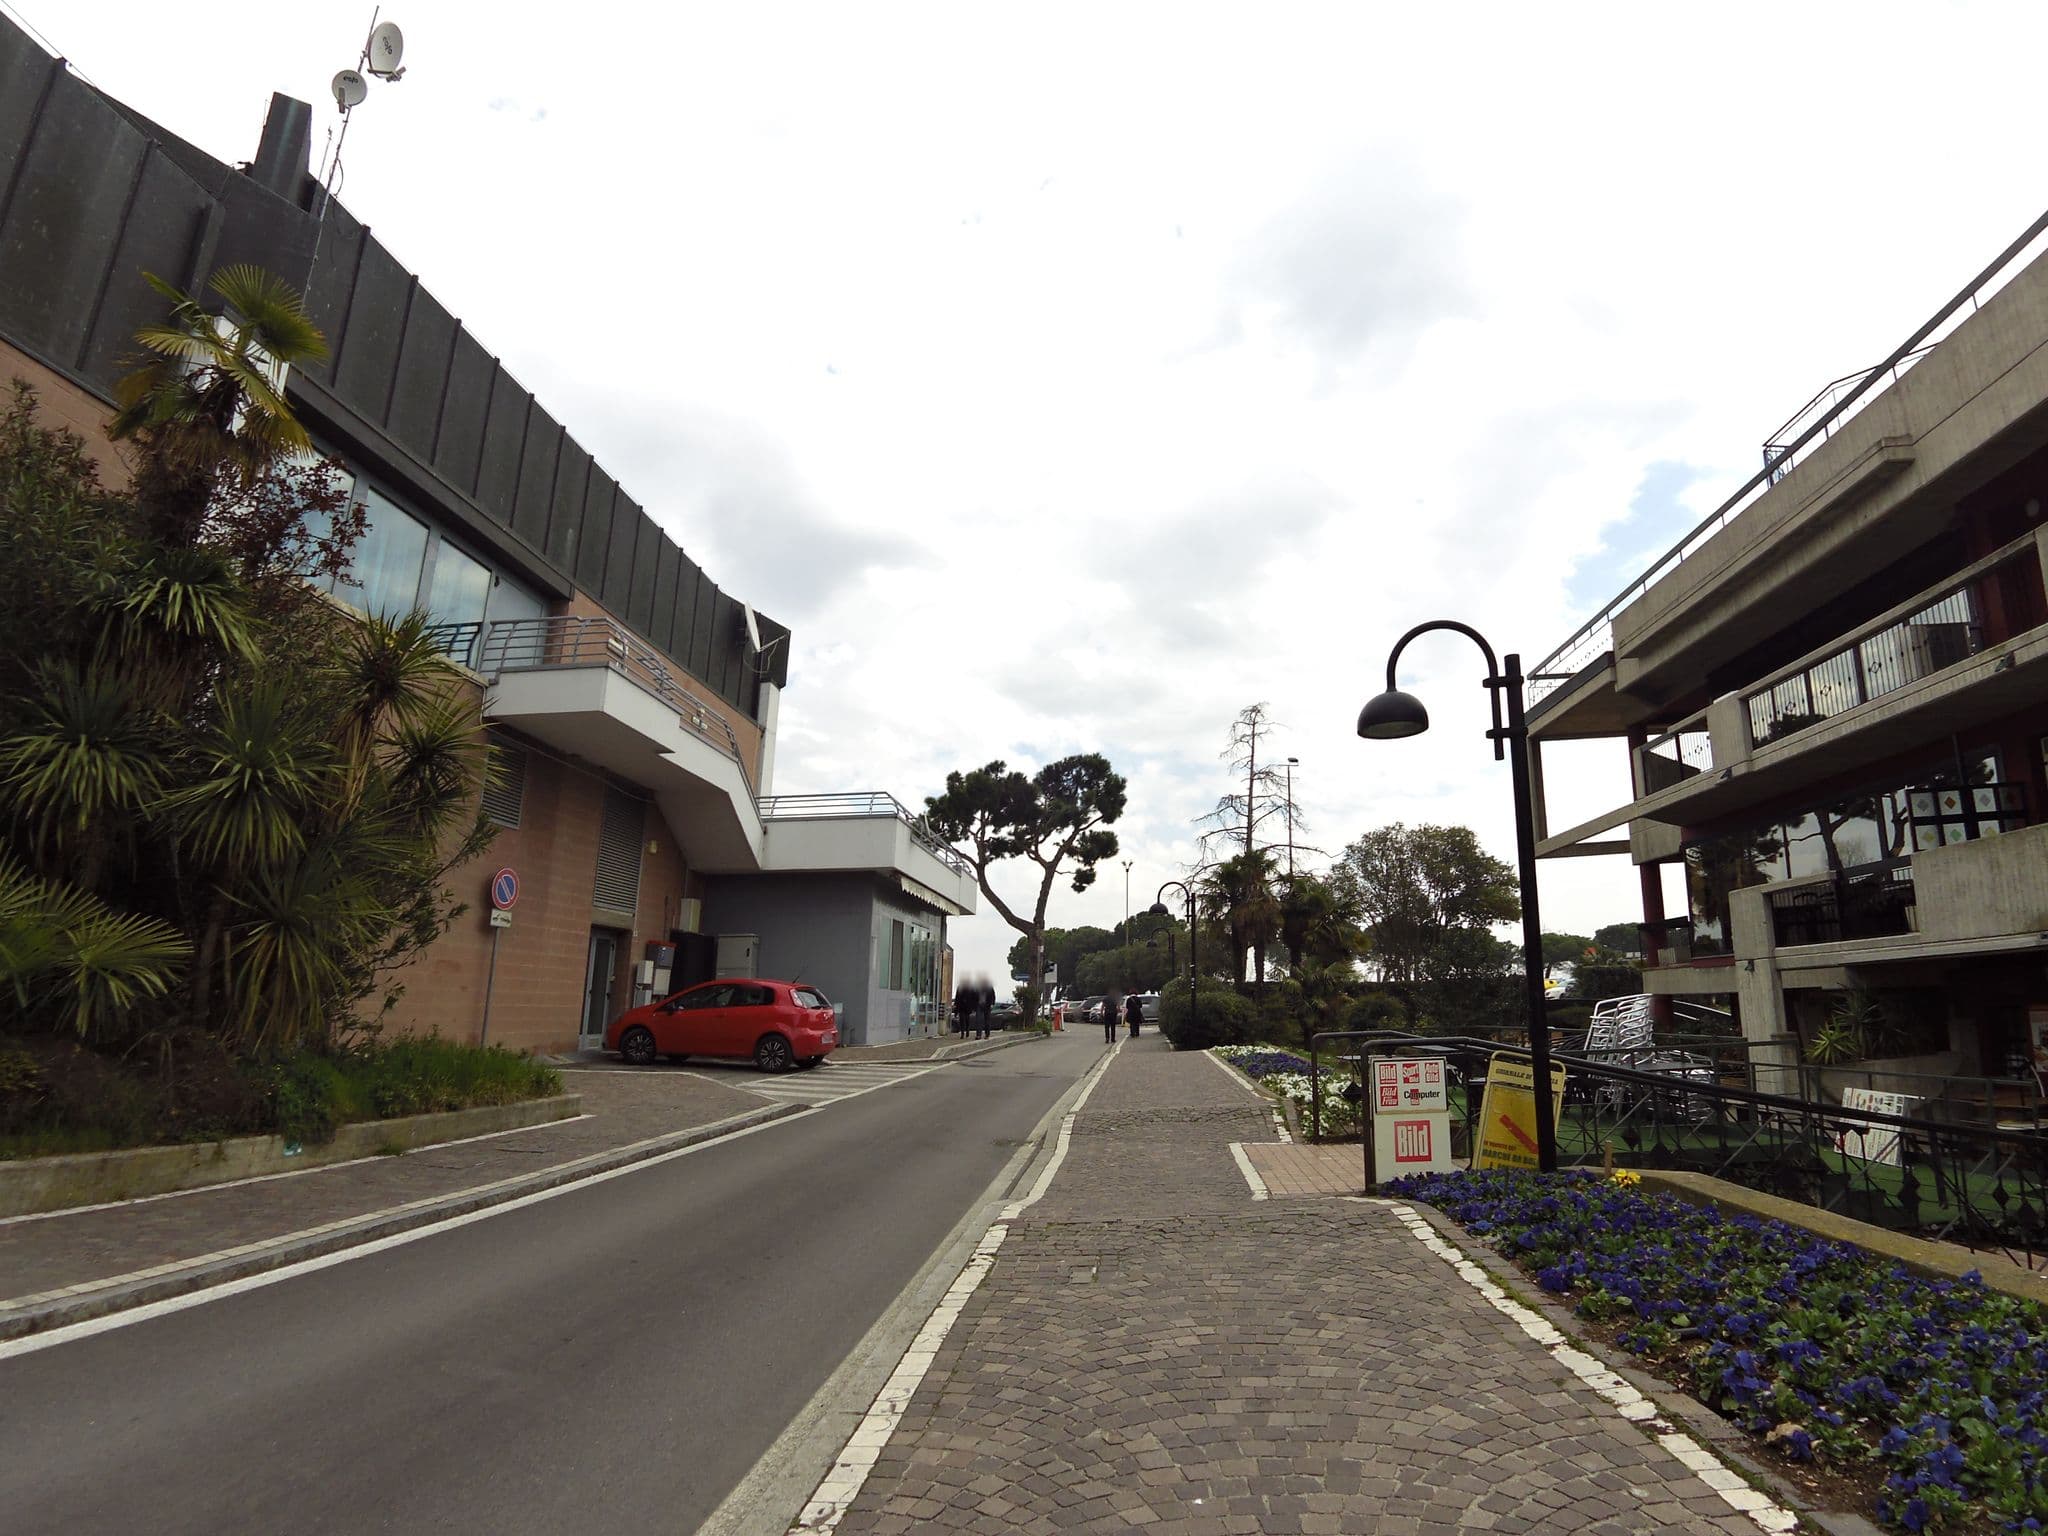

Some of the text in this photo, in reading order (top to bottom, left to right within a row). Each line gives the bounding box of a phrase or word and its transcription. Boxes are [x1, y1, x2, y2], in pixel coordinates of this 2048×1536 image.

[1380, 1065, 1397, 1080] Bild
[1426, 1072, 1440, 1082] Bild
[1381, 1087, 1397, 1097] Bild
[1403, 1090, 1440, 1100] Computer
[1397, 1125, 1429, 1157] Bild
